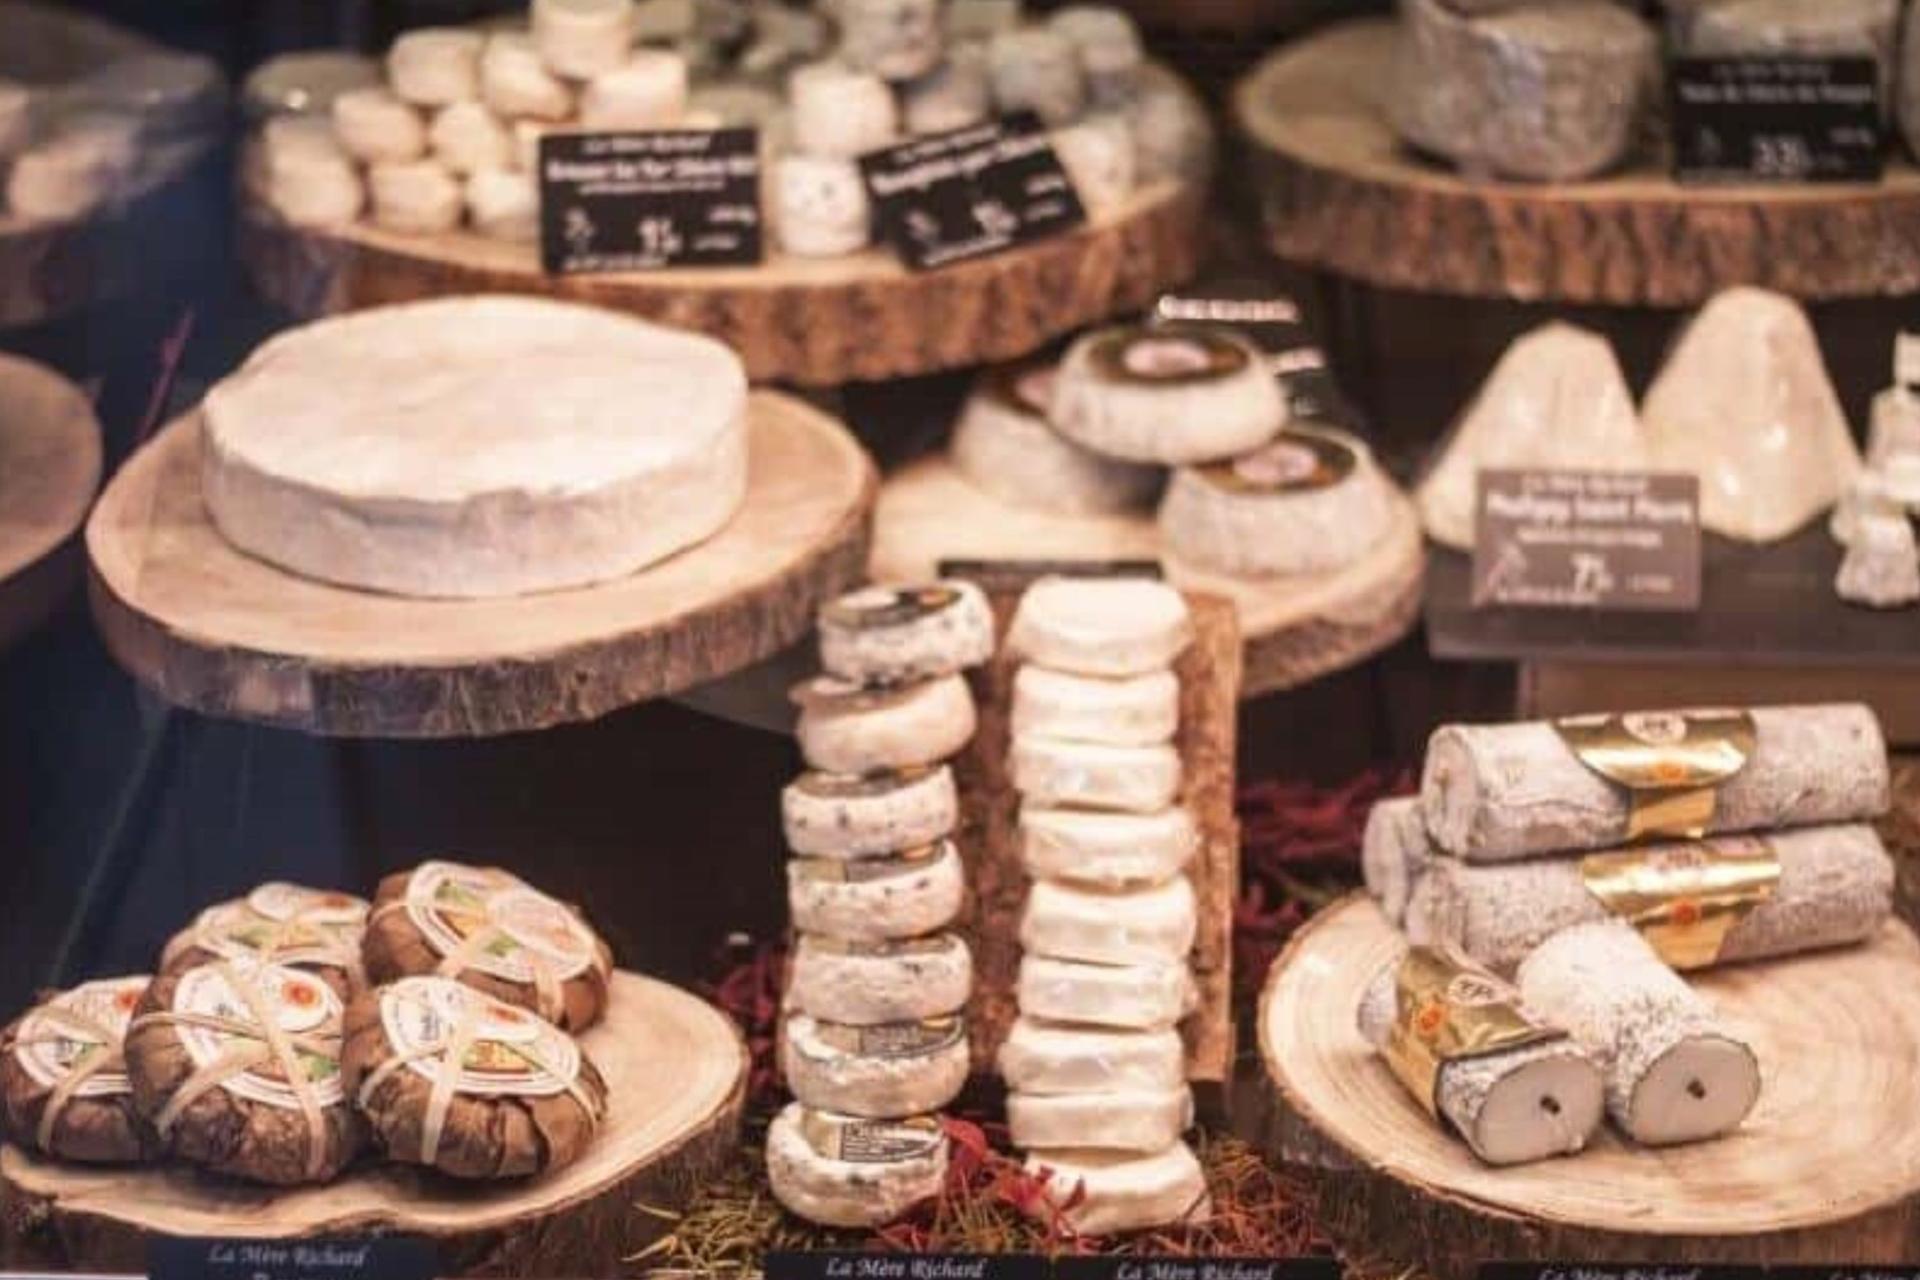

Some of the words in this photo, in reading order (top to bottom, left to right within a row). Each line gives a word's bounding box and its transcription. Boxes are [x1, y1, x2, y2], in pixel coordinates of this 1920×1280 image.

[207, 1243, 234, 1264] La
[826, 1257, 852, 1276] La
[856, 1257, 905, 1277] Mère
[911, 1257, 988, 1278] Richard
